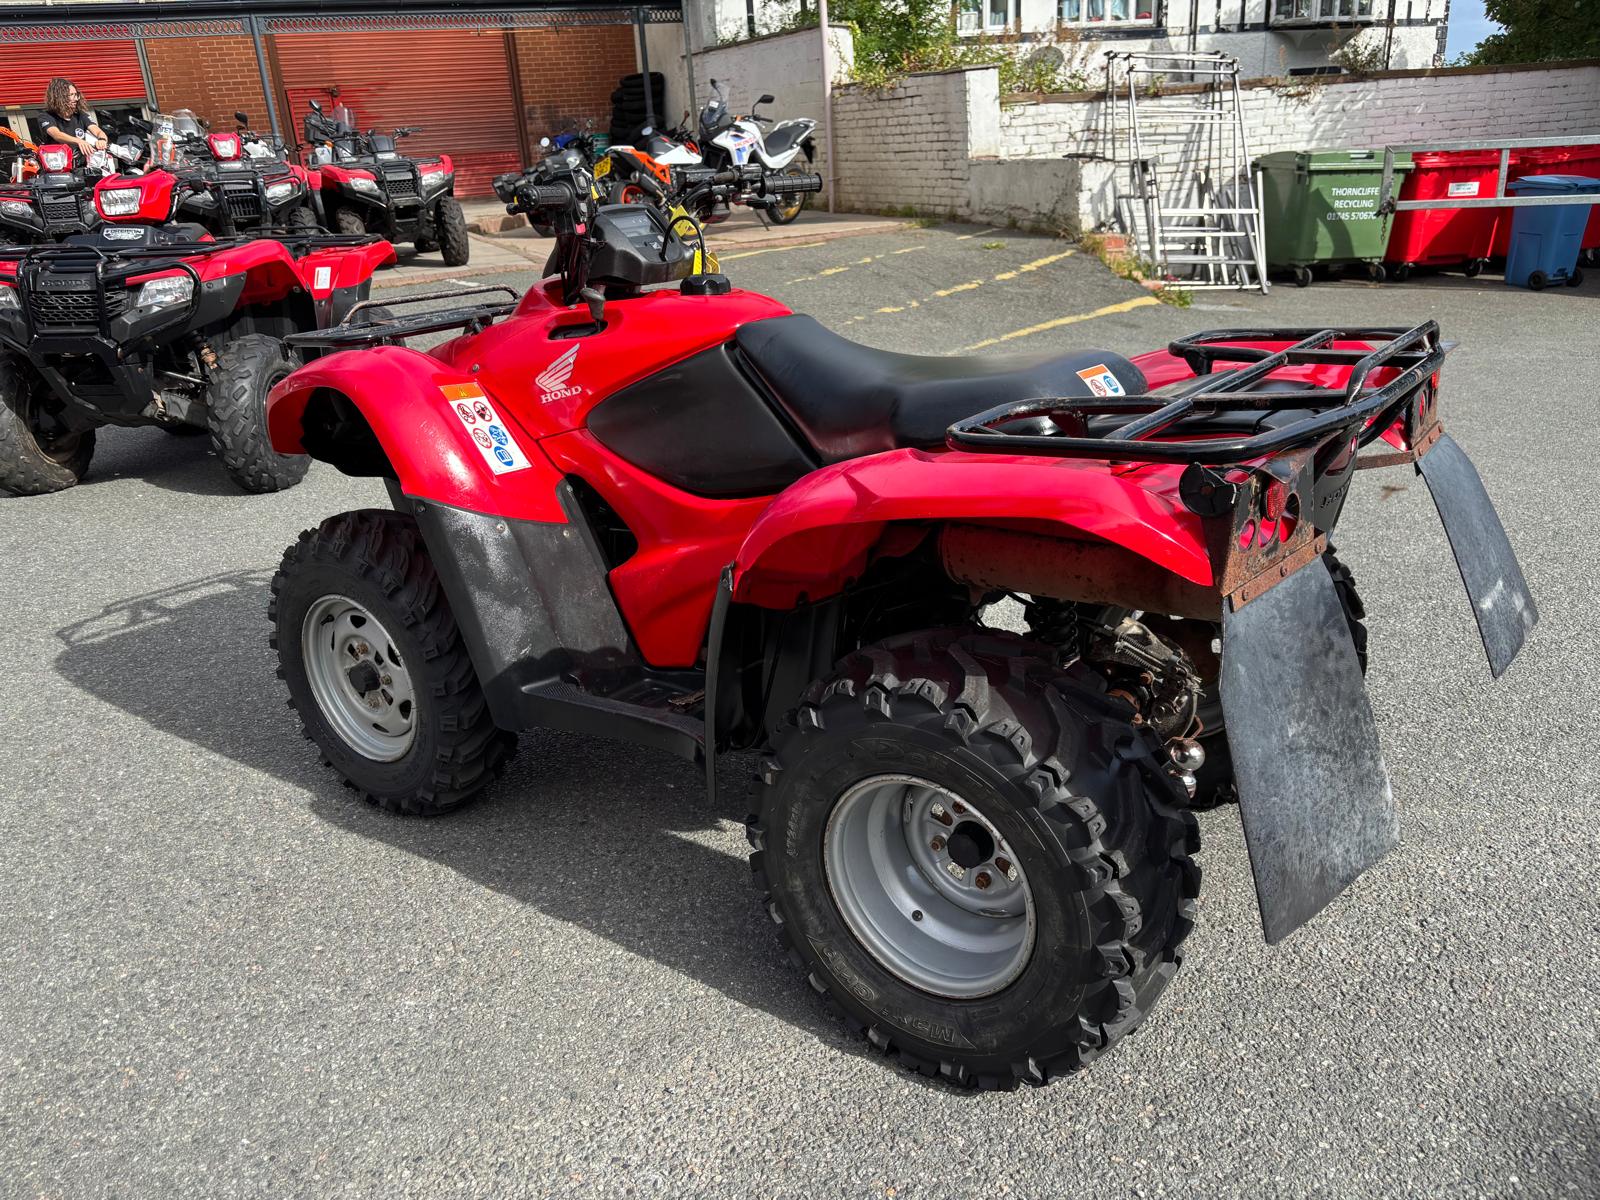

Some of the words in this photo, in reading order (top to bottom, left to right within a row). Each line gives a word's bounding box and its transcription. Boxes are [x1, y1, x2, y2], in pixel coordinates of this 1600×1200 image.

[1331, 186, 1380, 196] THORNCLIFFE
[1334, 199, 1374, 208] RECYCLING
[1326, 211, 1350, 220] 01745
[541, 385, 593, 404] HOND
